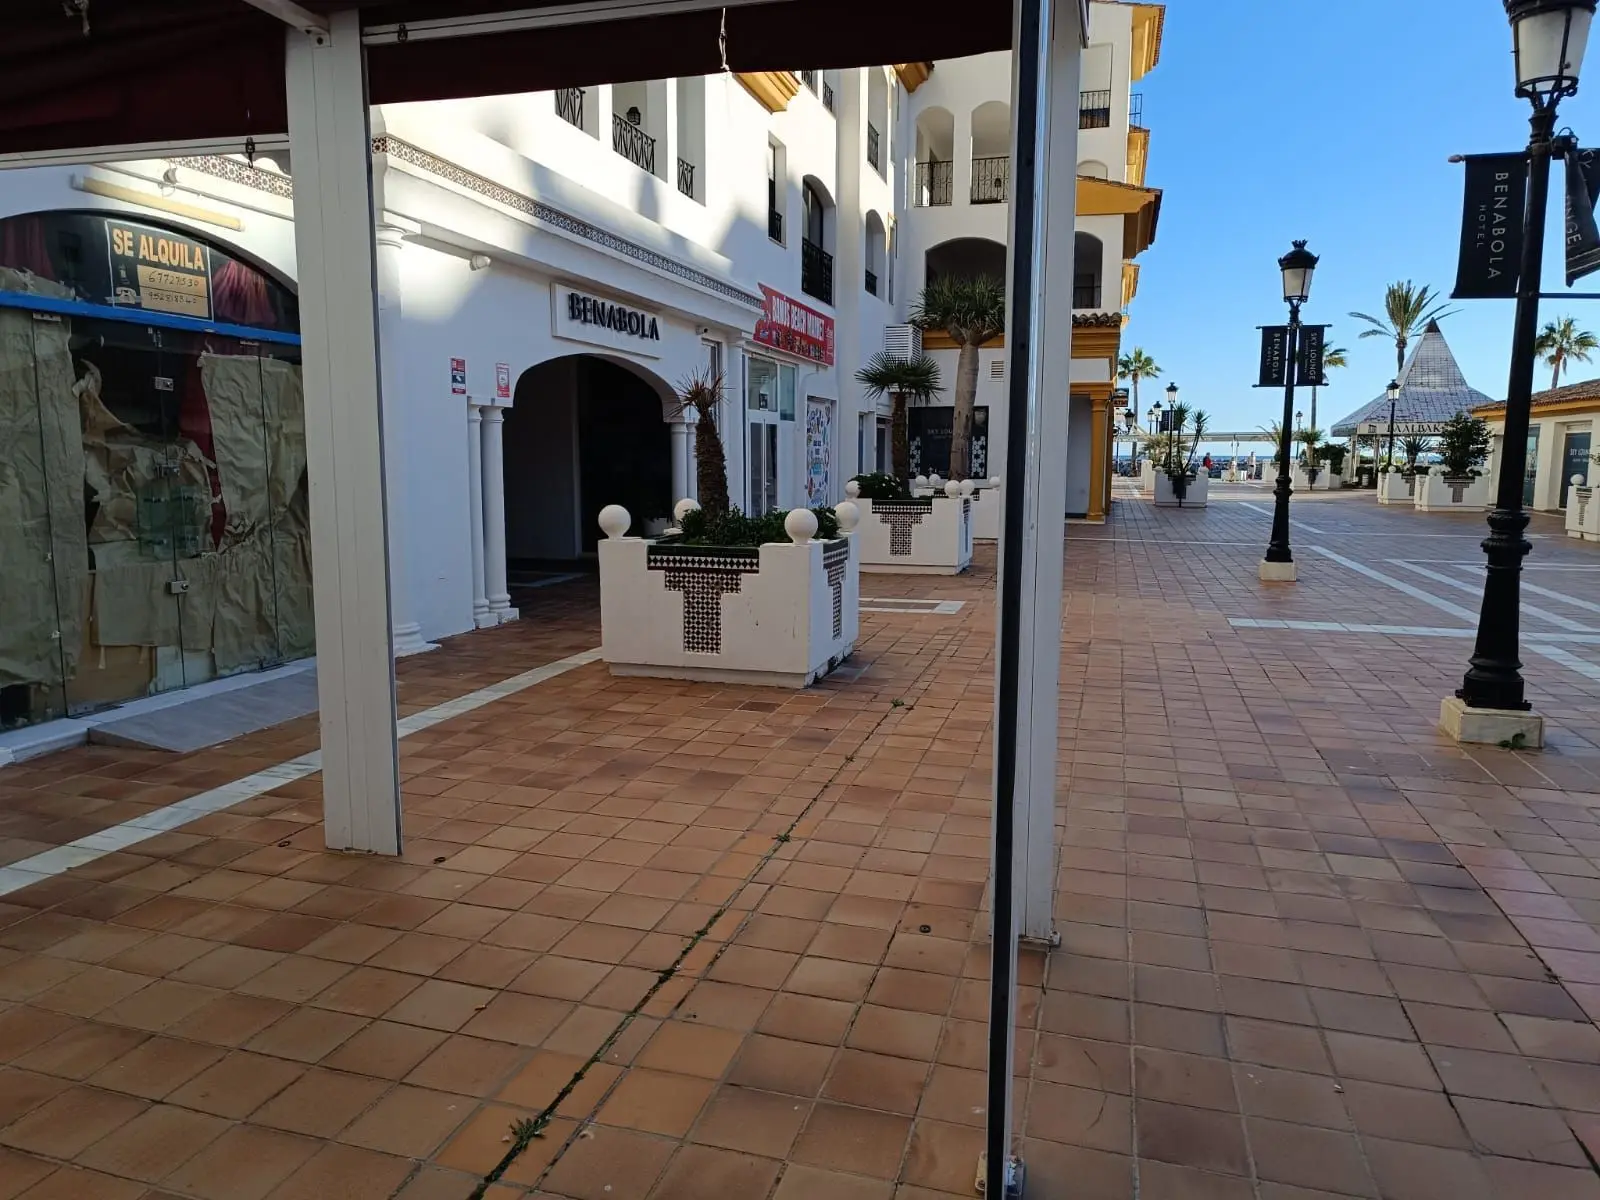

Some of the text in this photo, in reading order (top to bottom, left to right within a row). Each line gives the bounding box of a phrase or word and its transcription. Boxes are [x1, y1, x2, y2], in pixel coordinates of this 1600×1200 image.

[1476, 205, 1487, 248] HOTEL
[1488, 172, 1509, 279] BENABOLA
[112, 228, 205, 271] SE ALQUILA
[568, 292, 660, 341] BENABOLA
[1309, 349, 1317, 380] LOUNGE
